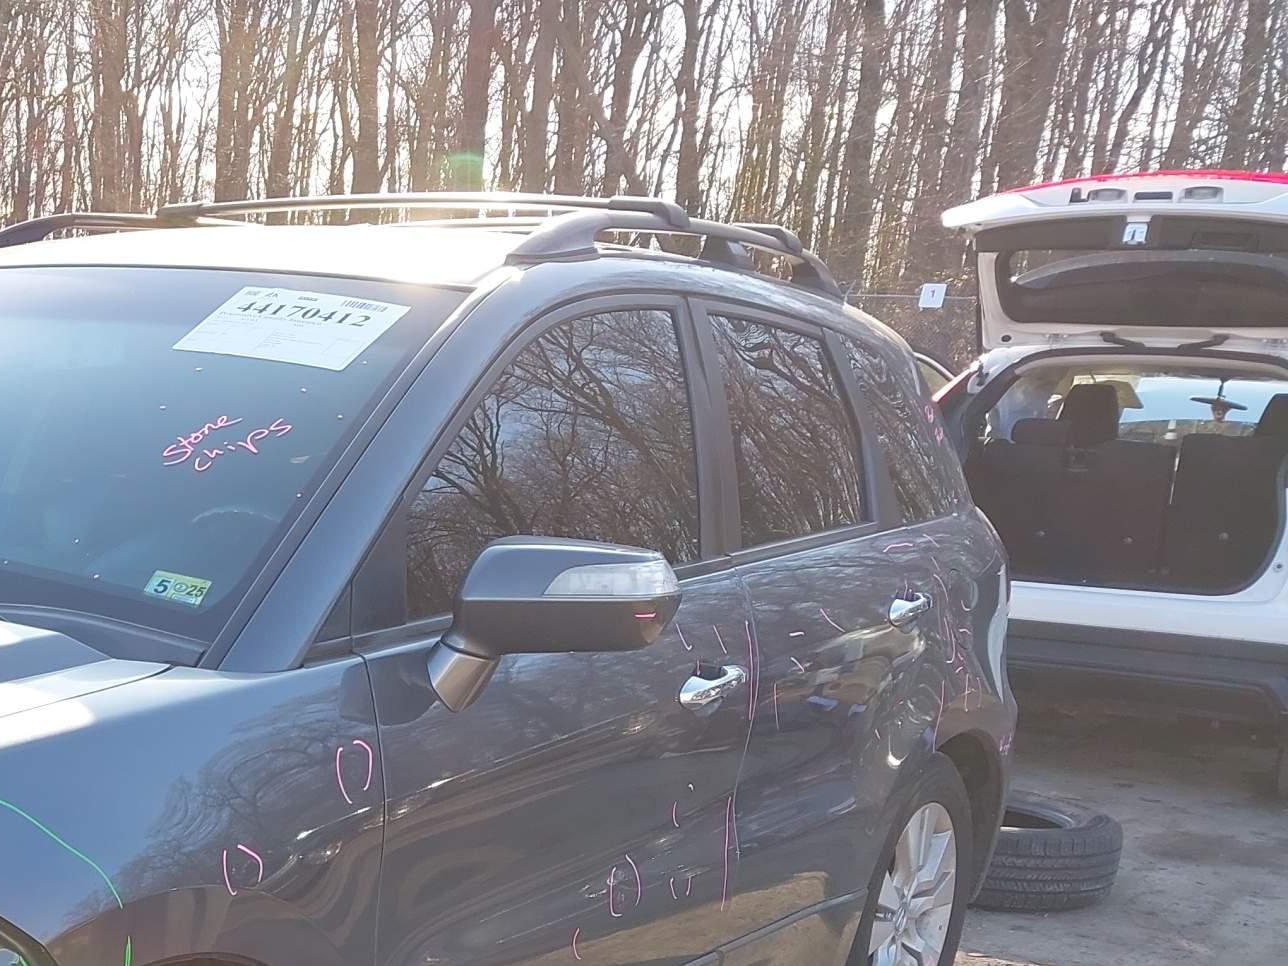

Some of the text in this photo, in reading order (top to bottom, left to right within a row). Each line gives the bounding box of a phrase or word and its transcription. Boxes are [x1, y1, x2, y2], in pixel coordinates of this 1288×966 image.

[237, 300, 372, 328] 44170412
[163, 415, 243, 466] Stone
[153, 579, 171, 594] 5
[186, 585, 206, 598] 25
